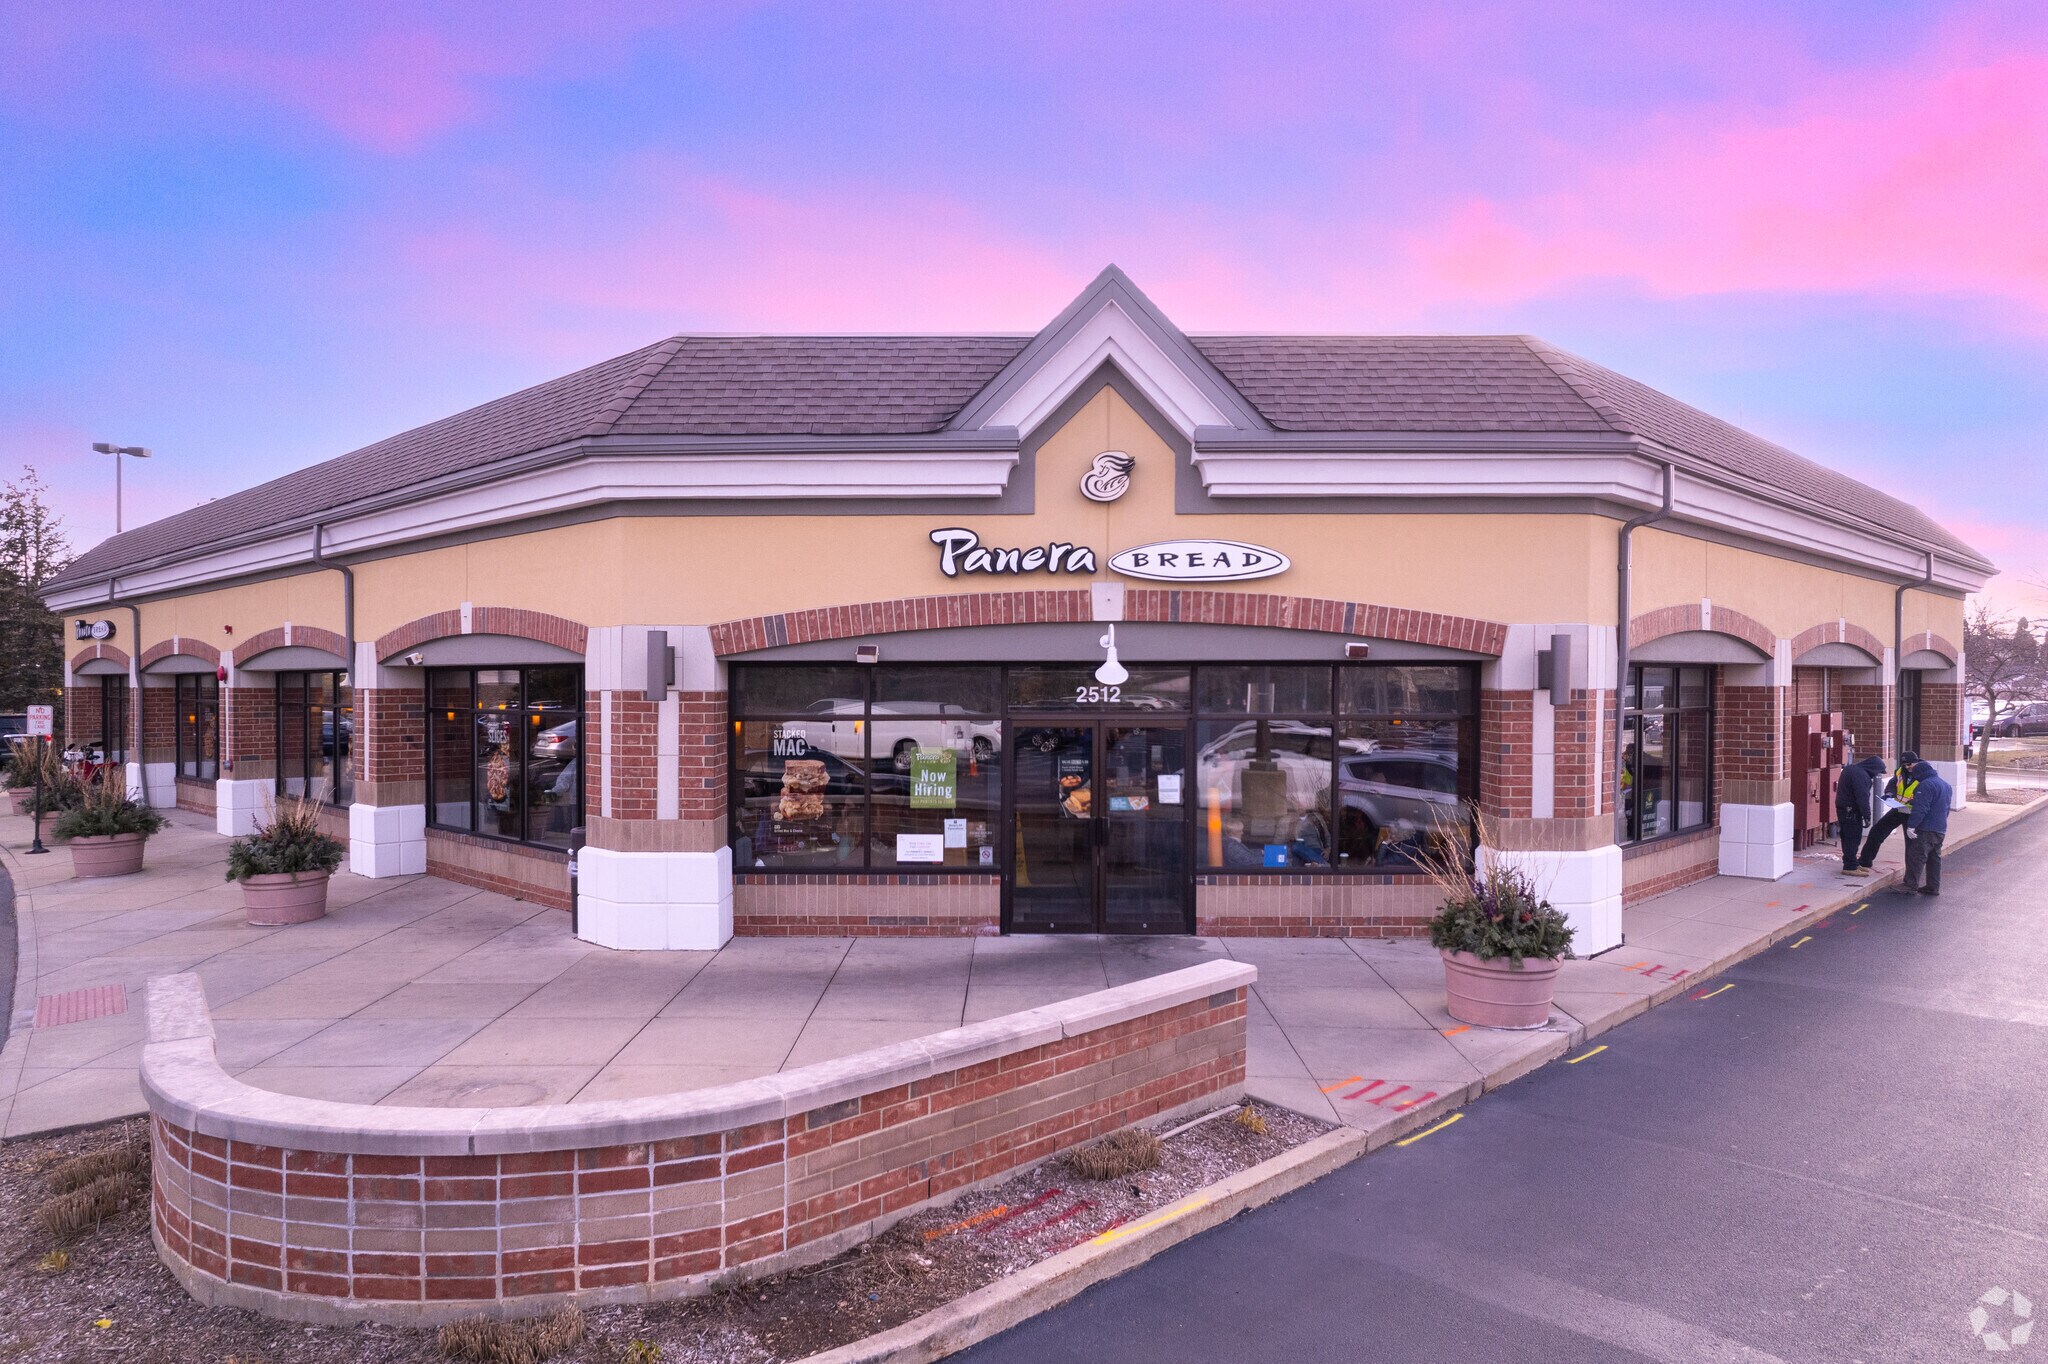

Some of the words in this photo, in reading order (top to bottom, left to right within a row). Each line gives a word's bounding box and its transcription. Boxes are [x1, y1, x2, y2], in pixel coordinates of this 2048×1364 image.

[929, 527, 1097, 578] Panera
[1132, 551, 1263, 568] BREAD
[1076, 686, 1121, 703] 2512
[774, 729, 806, 739] STACKED
[774, 739, 806, 756] MAC
[921, 769, 947, 782] Now
[914, 783, 952, 799] Hiring
